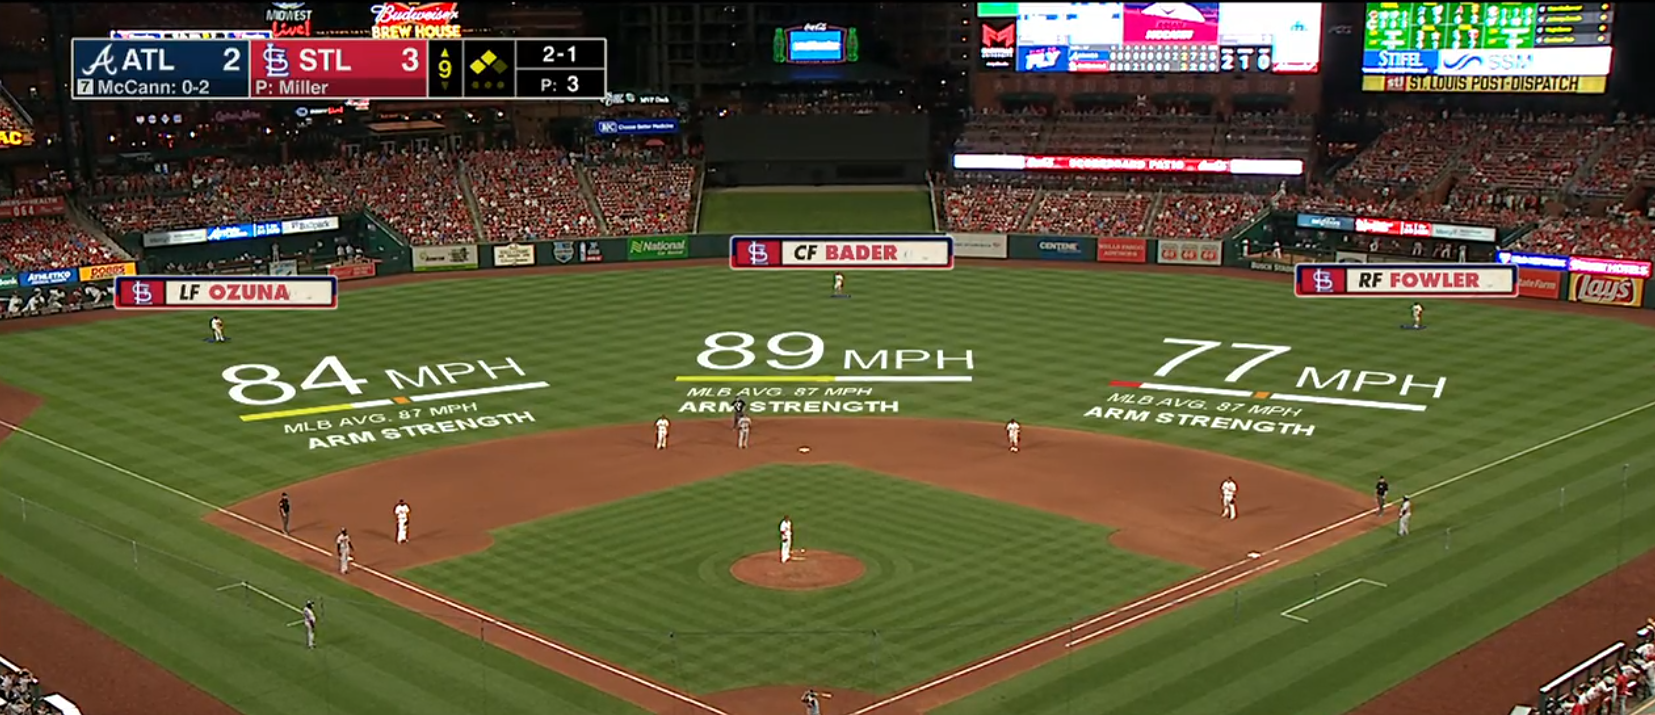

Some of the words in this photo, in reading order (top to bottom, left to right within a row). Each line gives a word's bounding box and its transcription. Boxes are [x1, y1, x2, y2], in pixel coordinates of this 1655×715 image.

[266, 9, 312, 21] MIDWEST
[371, 5, 459, 23] Budweiser
[272, 20, 311, 38] Live!
[371, 25, 411, 38] BREW
[415, 25, 461, 38] HOUSE
[1378, 51, 1423, 67] STIFEL
[1430, 76, 1468, 90] LOUIS
[1472, 76, 1579, 90] POST-DISPATCH
[644, 240, 685, 252] National
